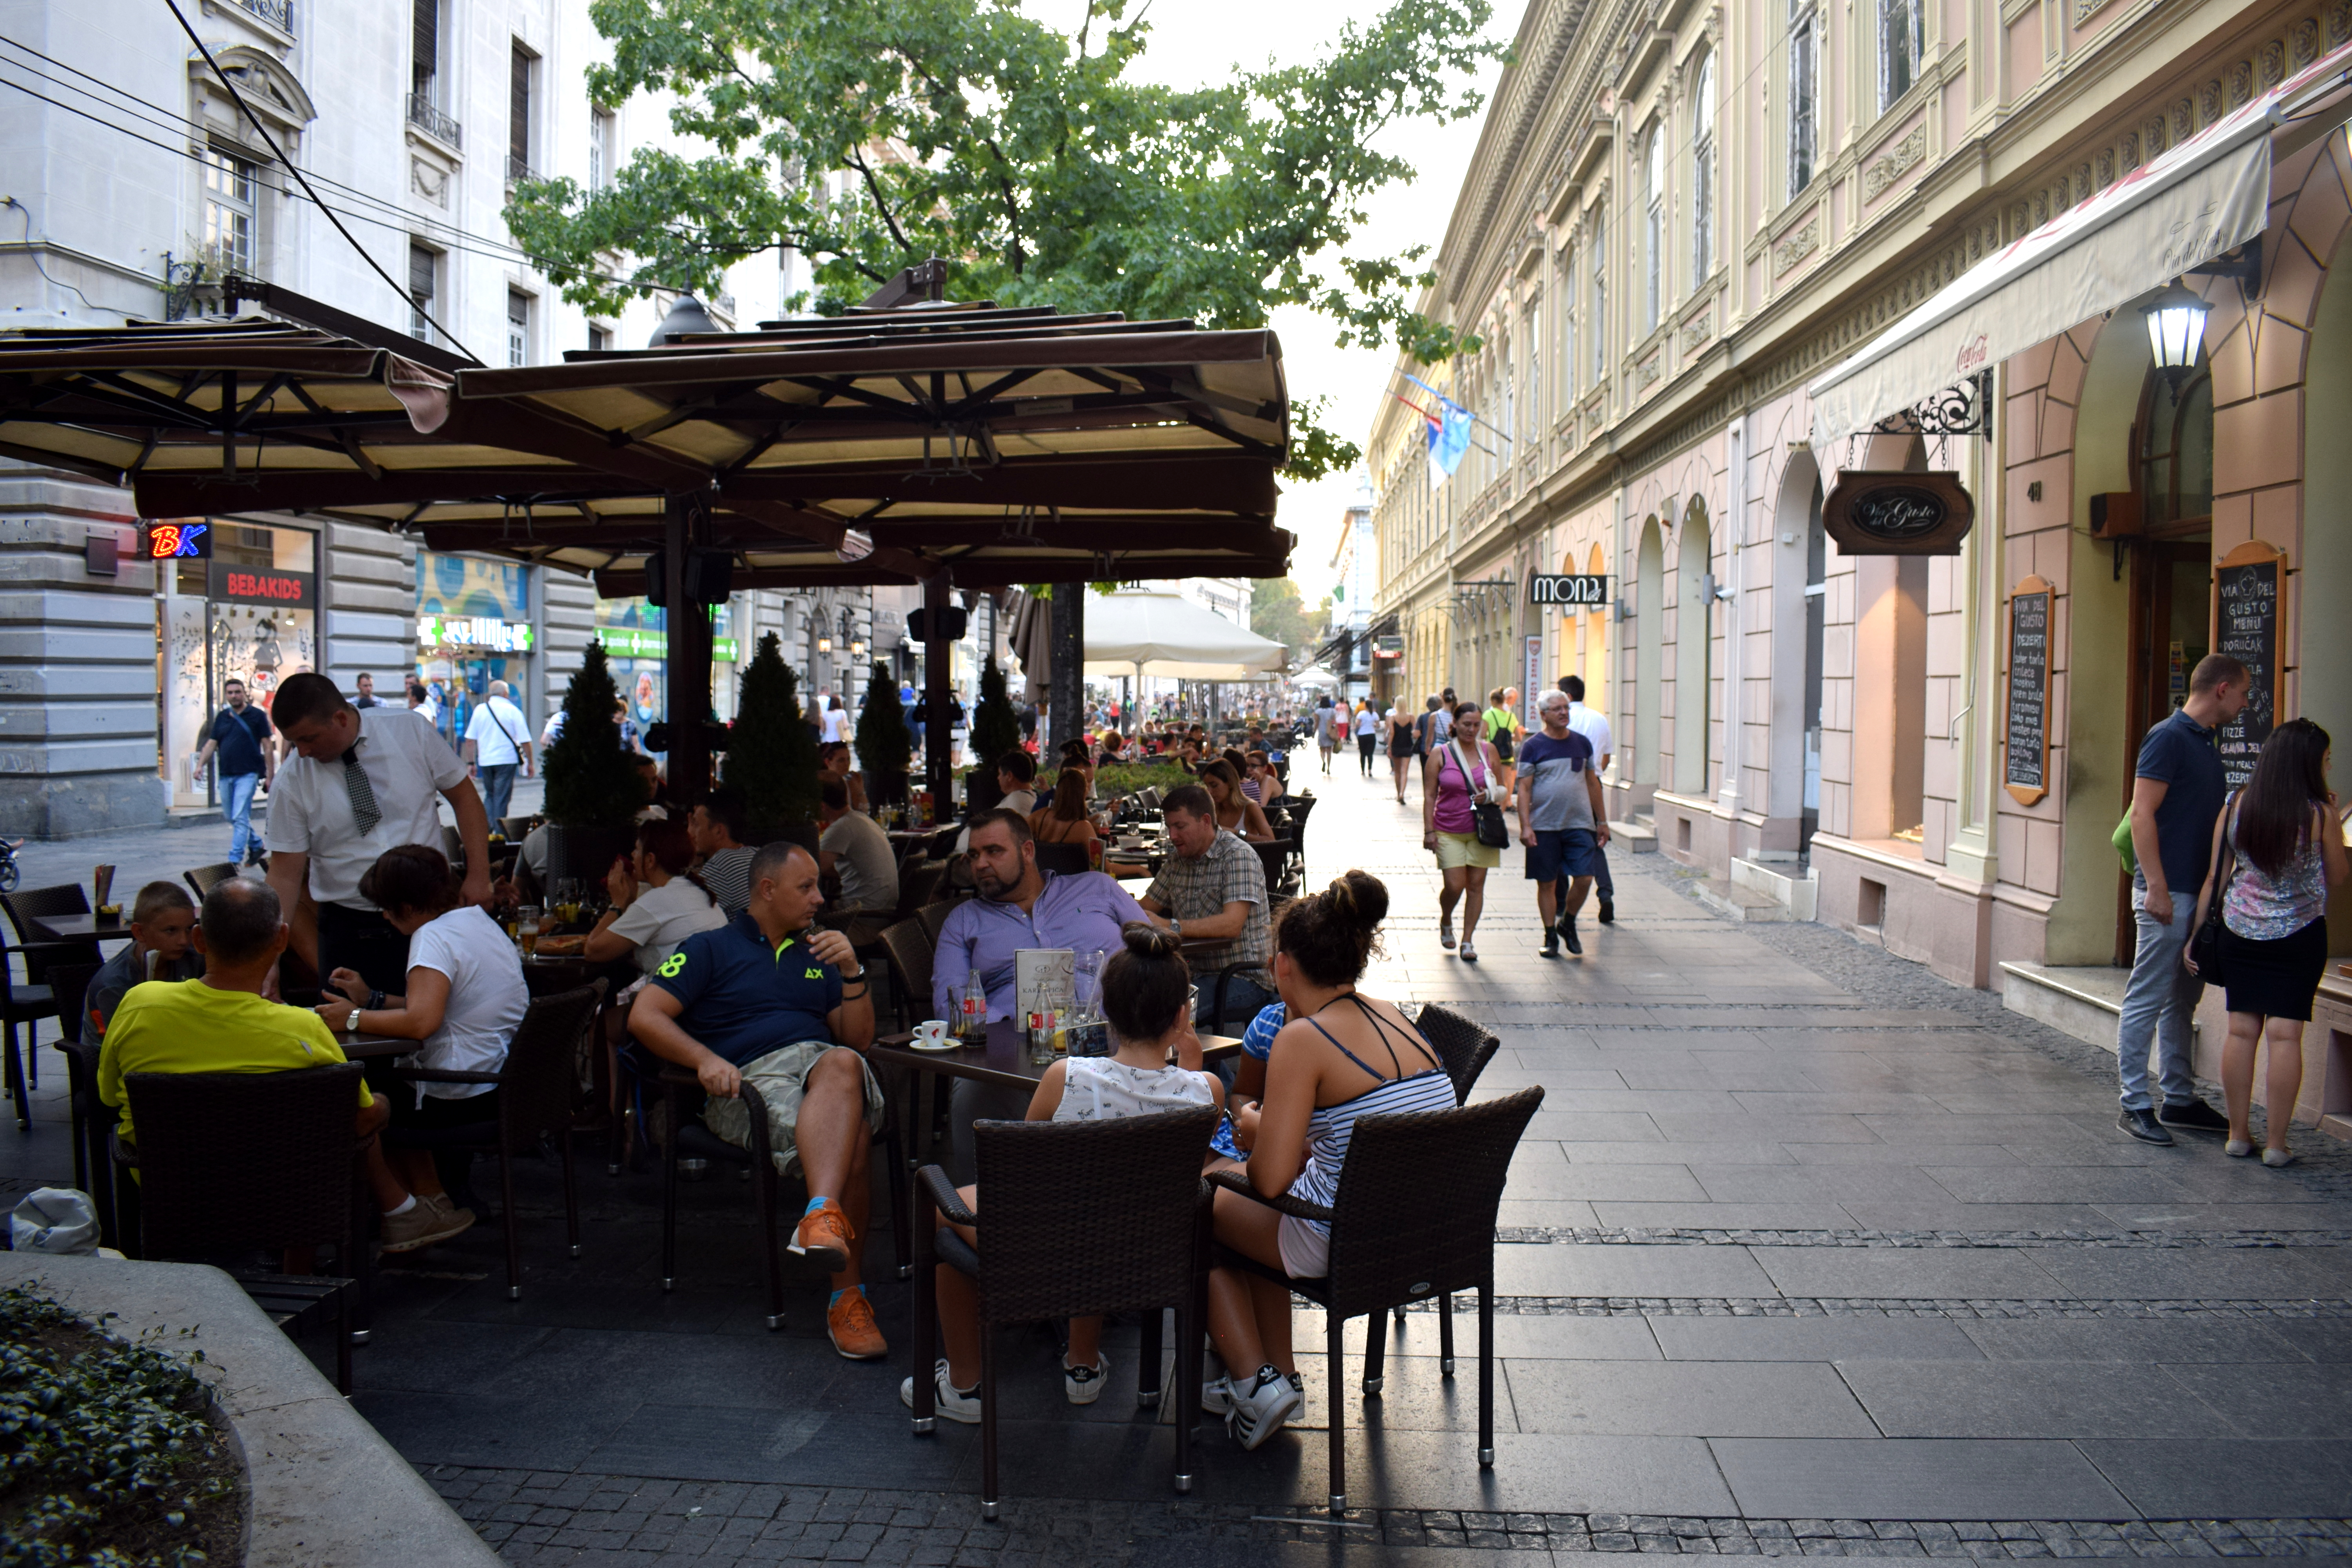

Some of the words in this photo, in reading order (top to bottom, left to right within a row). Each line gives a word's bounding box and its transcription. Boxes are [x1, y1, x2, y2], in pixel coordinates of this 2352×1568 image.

[2183, 239, 2198, 263] del
[1884, 497, 1935, 528] Gusto
[151, 524, 207, 557] BK
[228, 573, 302, 600] BEBAKIDS
[2221, 584, 2238, 597] VIA
[2257, 581, 2275, 597] DEL
[2019, 600, 2029, 612] VIA
[2033, 595, 2045, 611] DEL
[2229, 601, 2267, 617] GUSTO
[2019, 614, 2044, 627] GUSTO
[2233, 616, 2261, 630] MENU
[2222, 727, 2245, 738] PIZZE
[2220, 741, 2246, 754] GLAVNA
[2236, 760, 2256, 769] MEALS
[2225, 771, 2251, 784] EZERT
